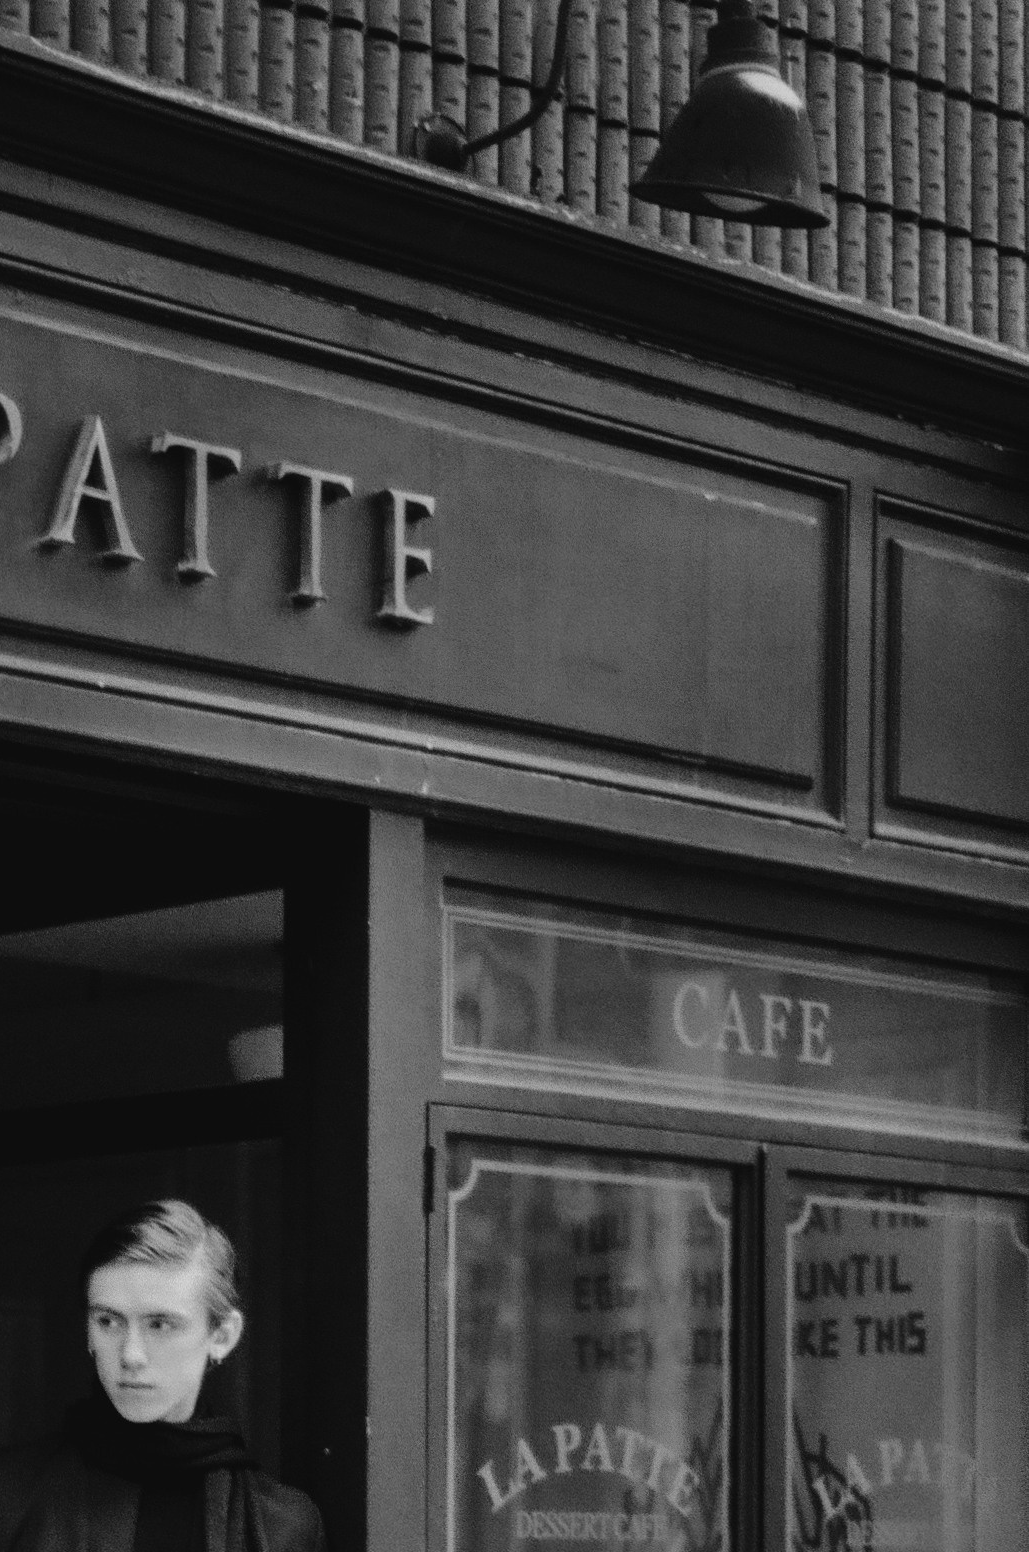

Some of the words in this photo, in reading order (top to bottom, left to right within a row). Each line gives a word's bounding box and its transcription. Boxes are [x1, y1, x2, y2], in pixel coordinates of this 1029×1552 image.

[674, 980, 834, 1066] CAFE
[795, 1252, 912, 1301] UNTIL
[854, 1310, 928, 1357] THIS
[477, 1437, 548, 1514] LA
[551, 1422, 702, 1518] PATTE
[516, 1510, 608, 1541] DESSERT
[612, 1512, 671, 1541] CAFE
